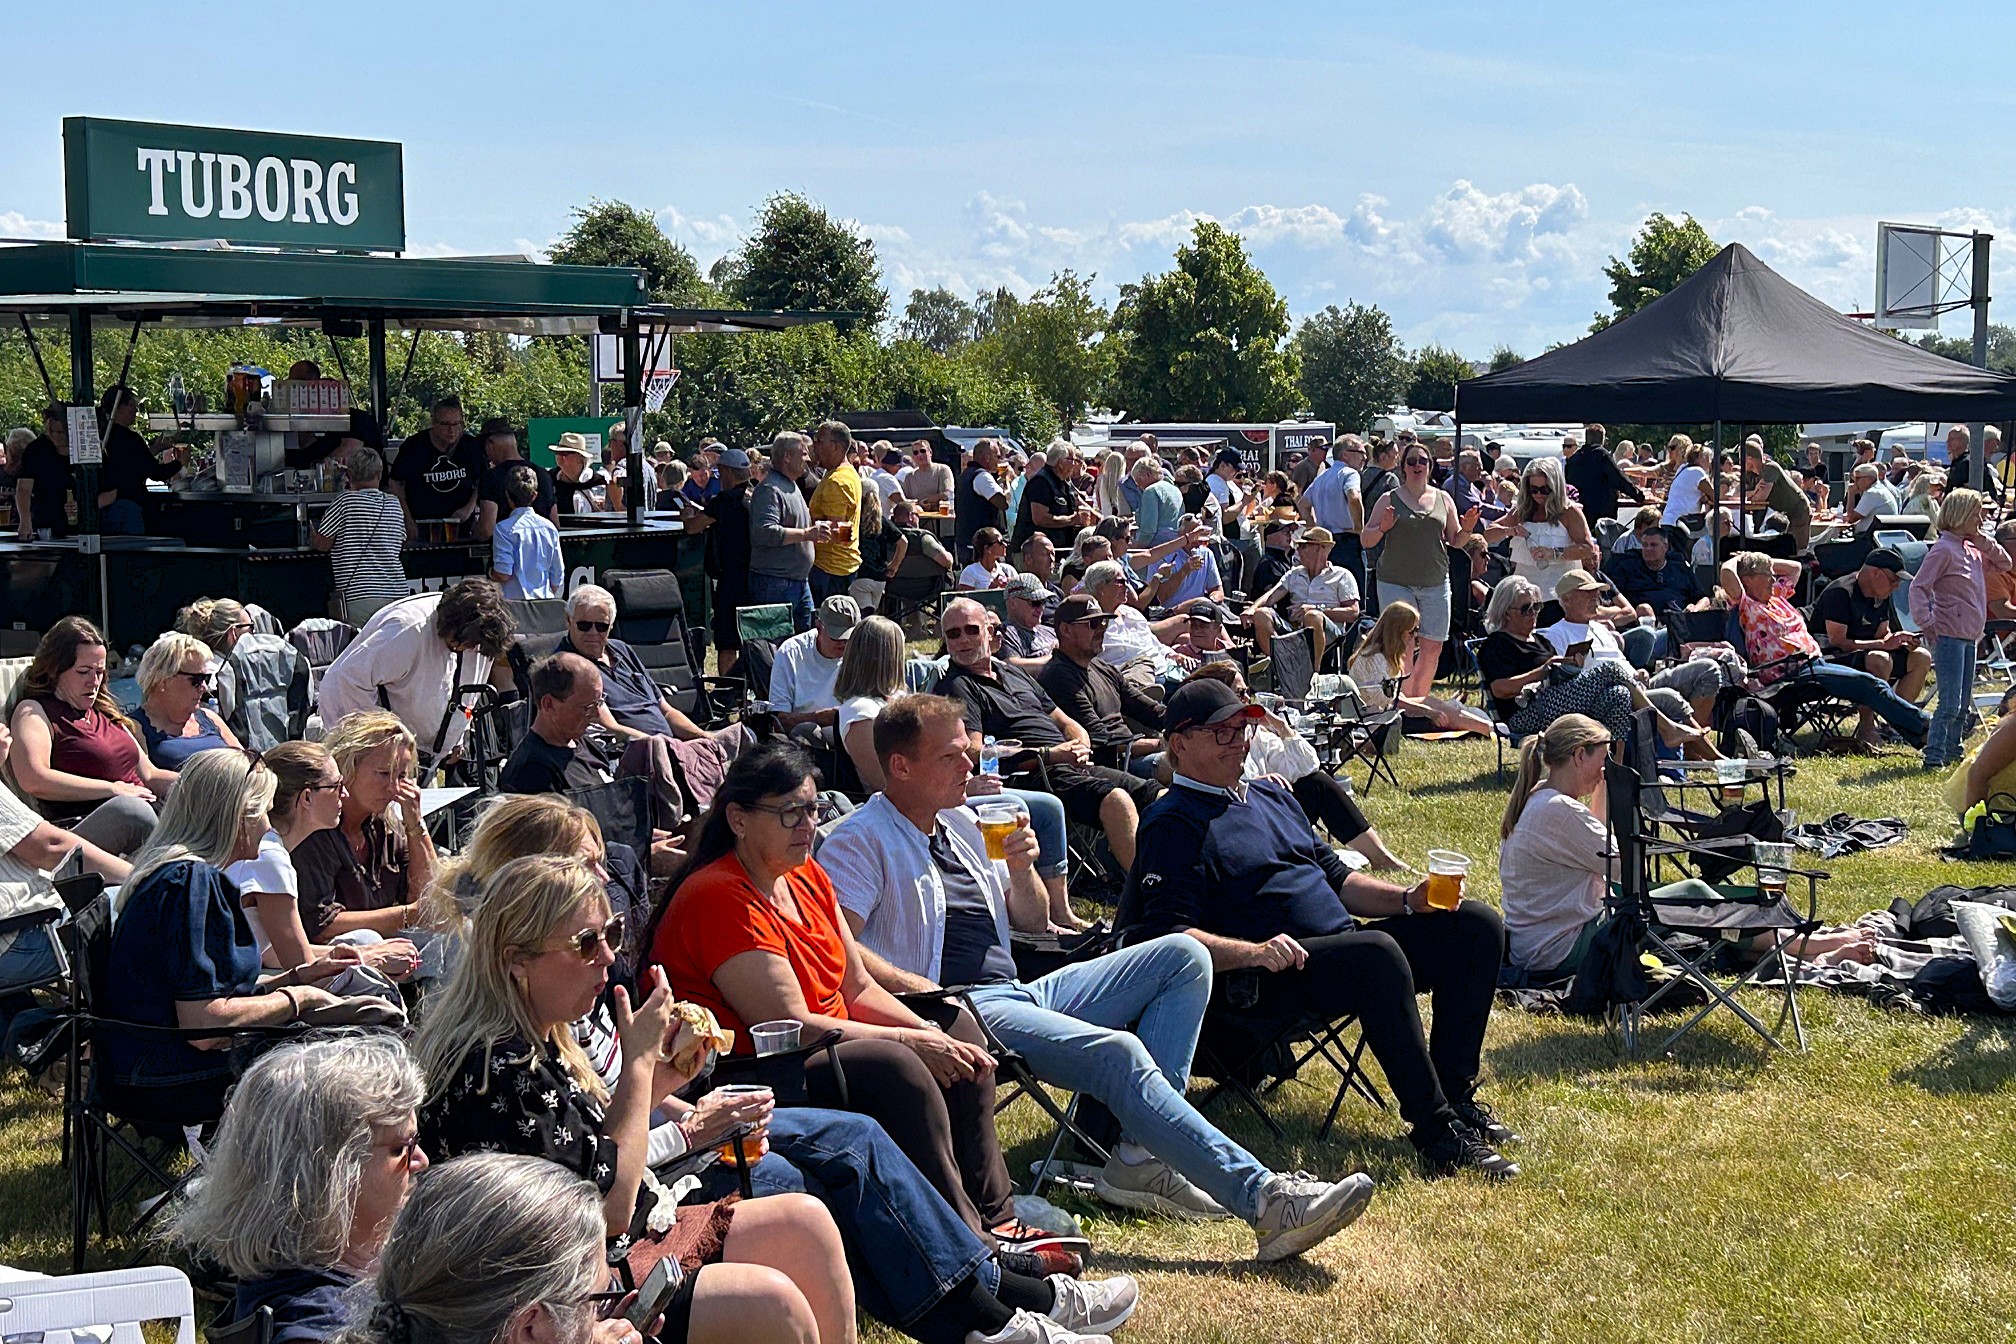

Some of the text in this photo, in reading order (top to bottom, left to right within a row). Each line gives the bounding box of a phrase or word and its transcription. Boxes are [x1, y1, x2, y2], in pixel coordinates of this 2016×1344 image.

[137, 147, 359, 226] TUBORG
[1284, 435, 1303, 448] THAI
[423, 467, 467, 483] TUBORG
